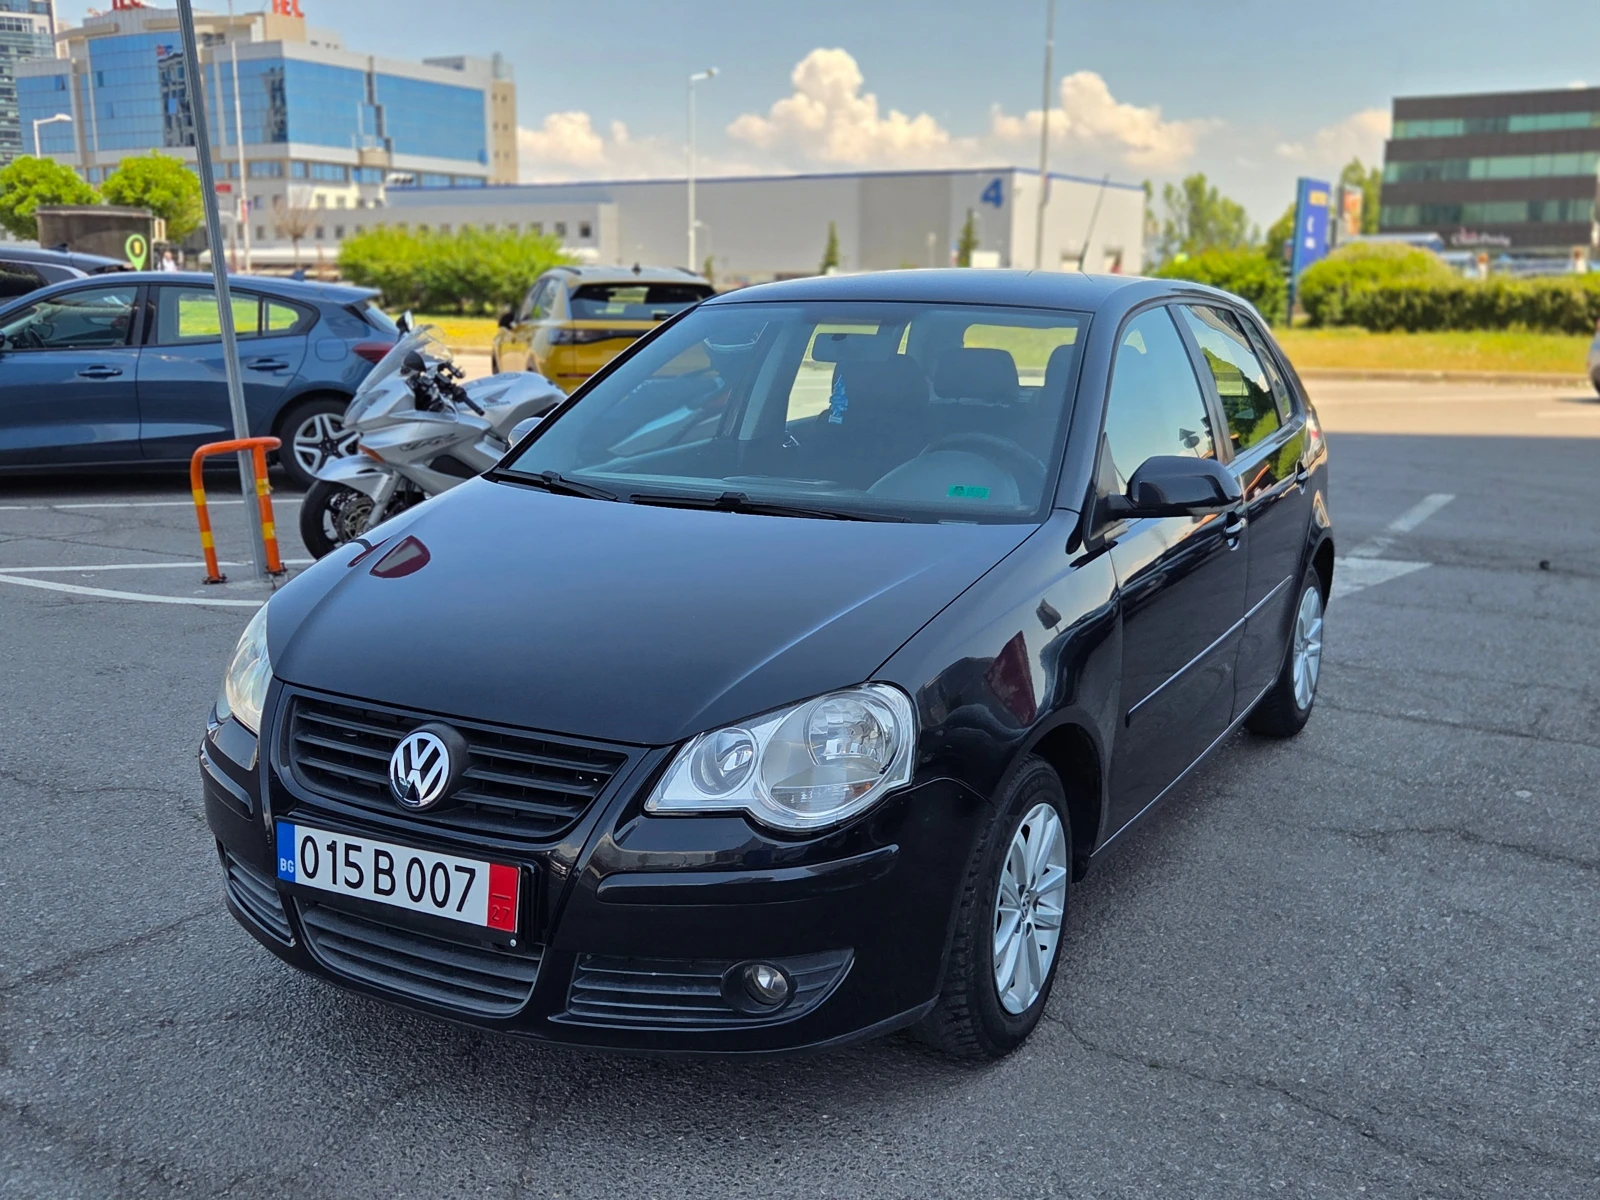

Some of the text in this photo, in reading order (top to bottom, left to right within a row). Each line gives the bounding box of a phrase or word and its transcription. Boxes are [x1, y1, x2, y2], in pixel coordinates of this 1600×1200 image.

[981, 178, 1003, 208] 4
[280, 857, 294, 873] BG
[491, 904, 510, 922] 27
